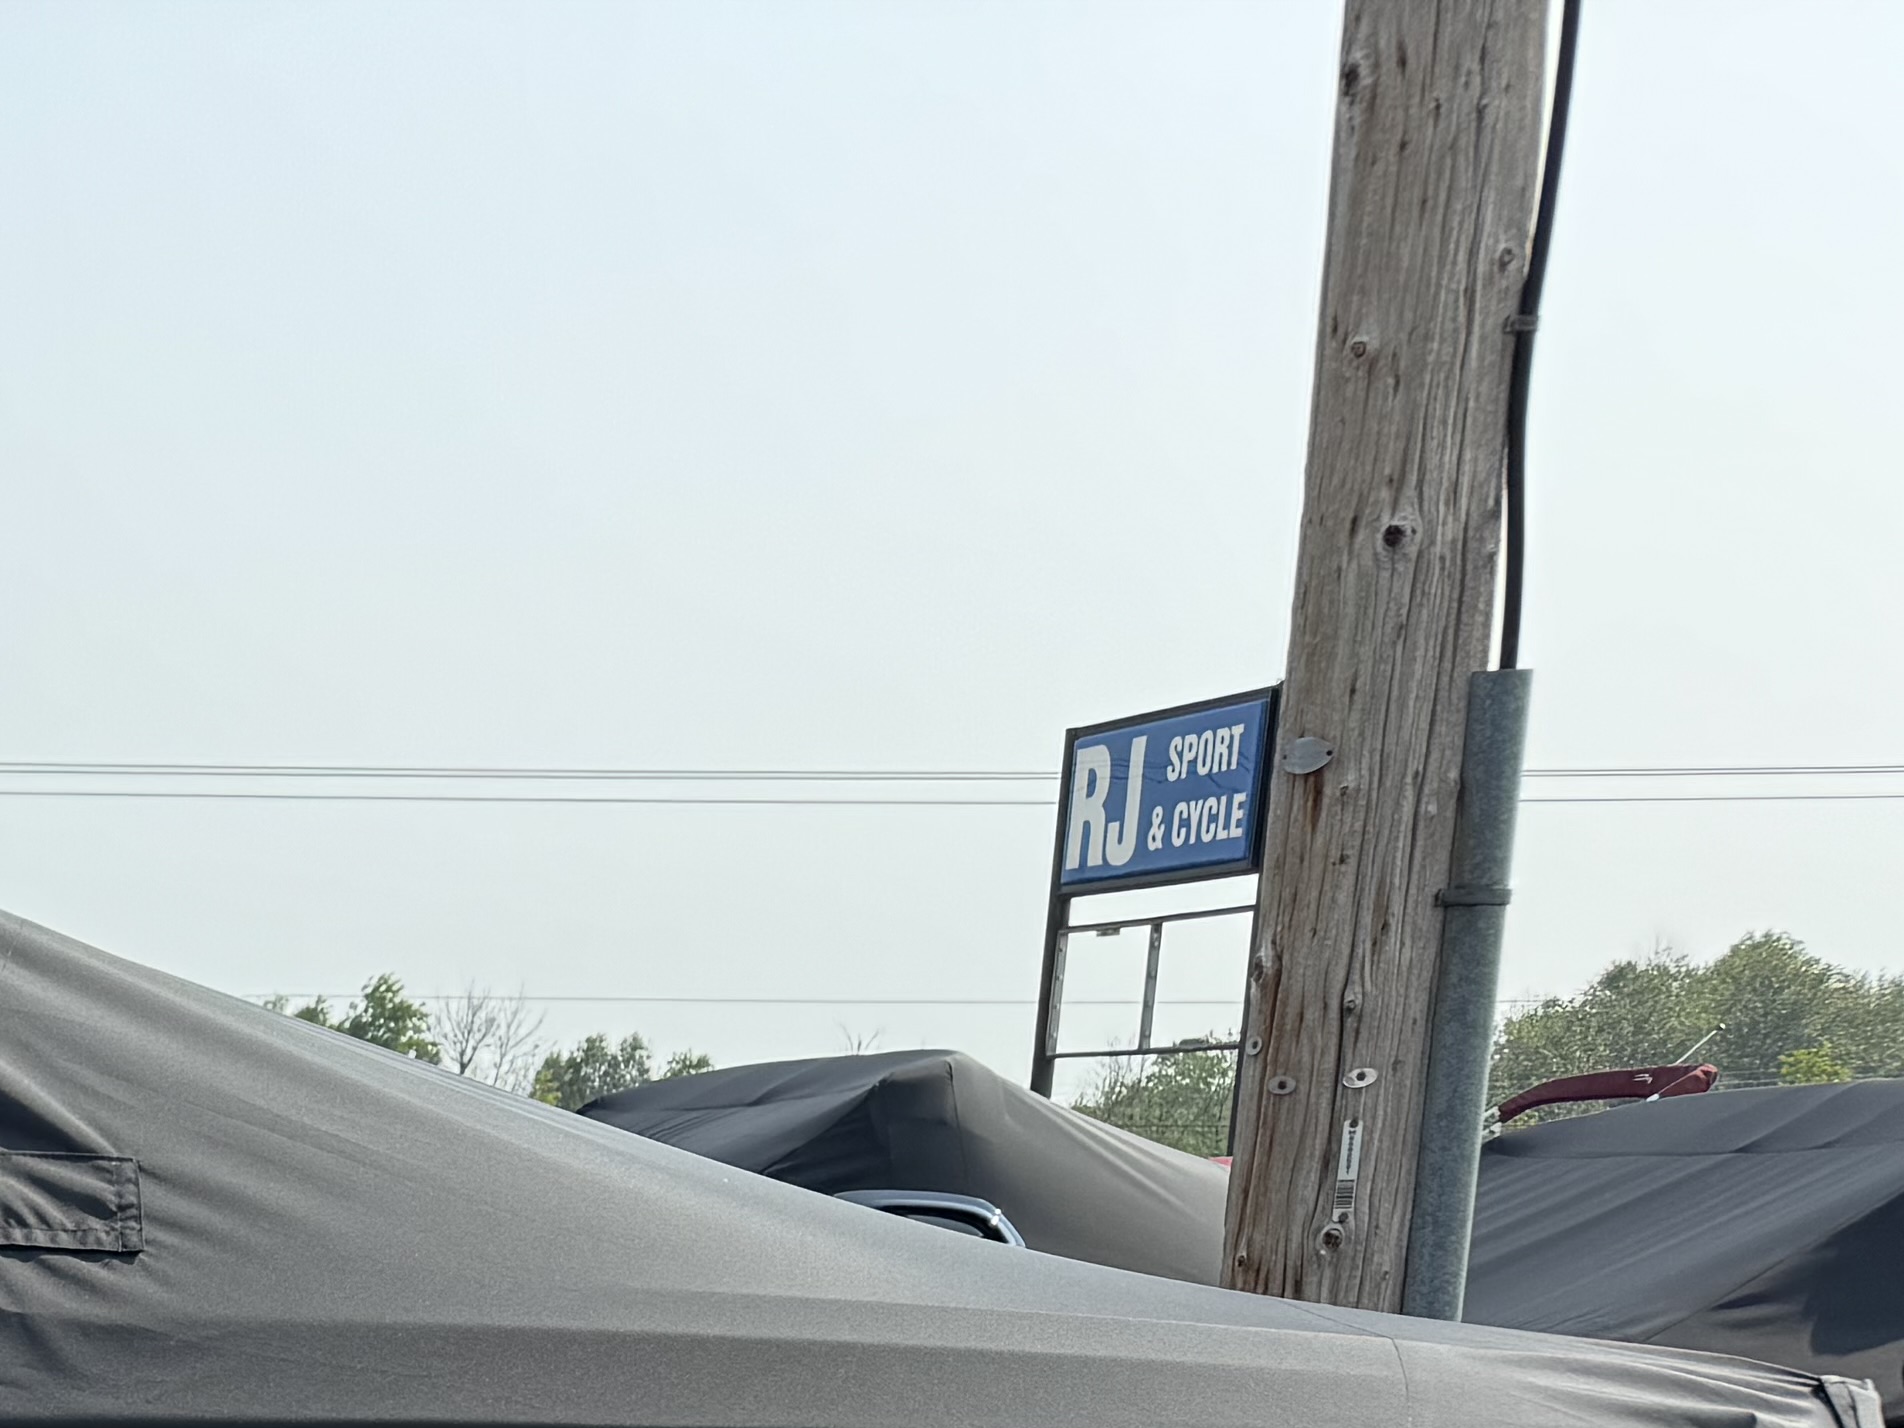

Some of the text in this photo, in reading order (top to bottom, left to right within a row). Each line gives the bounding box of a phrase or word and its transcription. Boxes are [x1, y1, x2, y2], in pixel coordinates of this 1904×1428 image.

[1167, 724, 1244, 782] SPORT
[1065, 736, 1147, 870] RJ
[1147, 793, 1247, 851] & CYCLE
